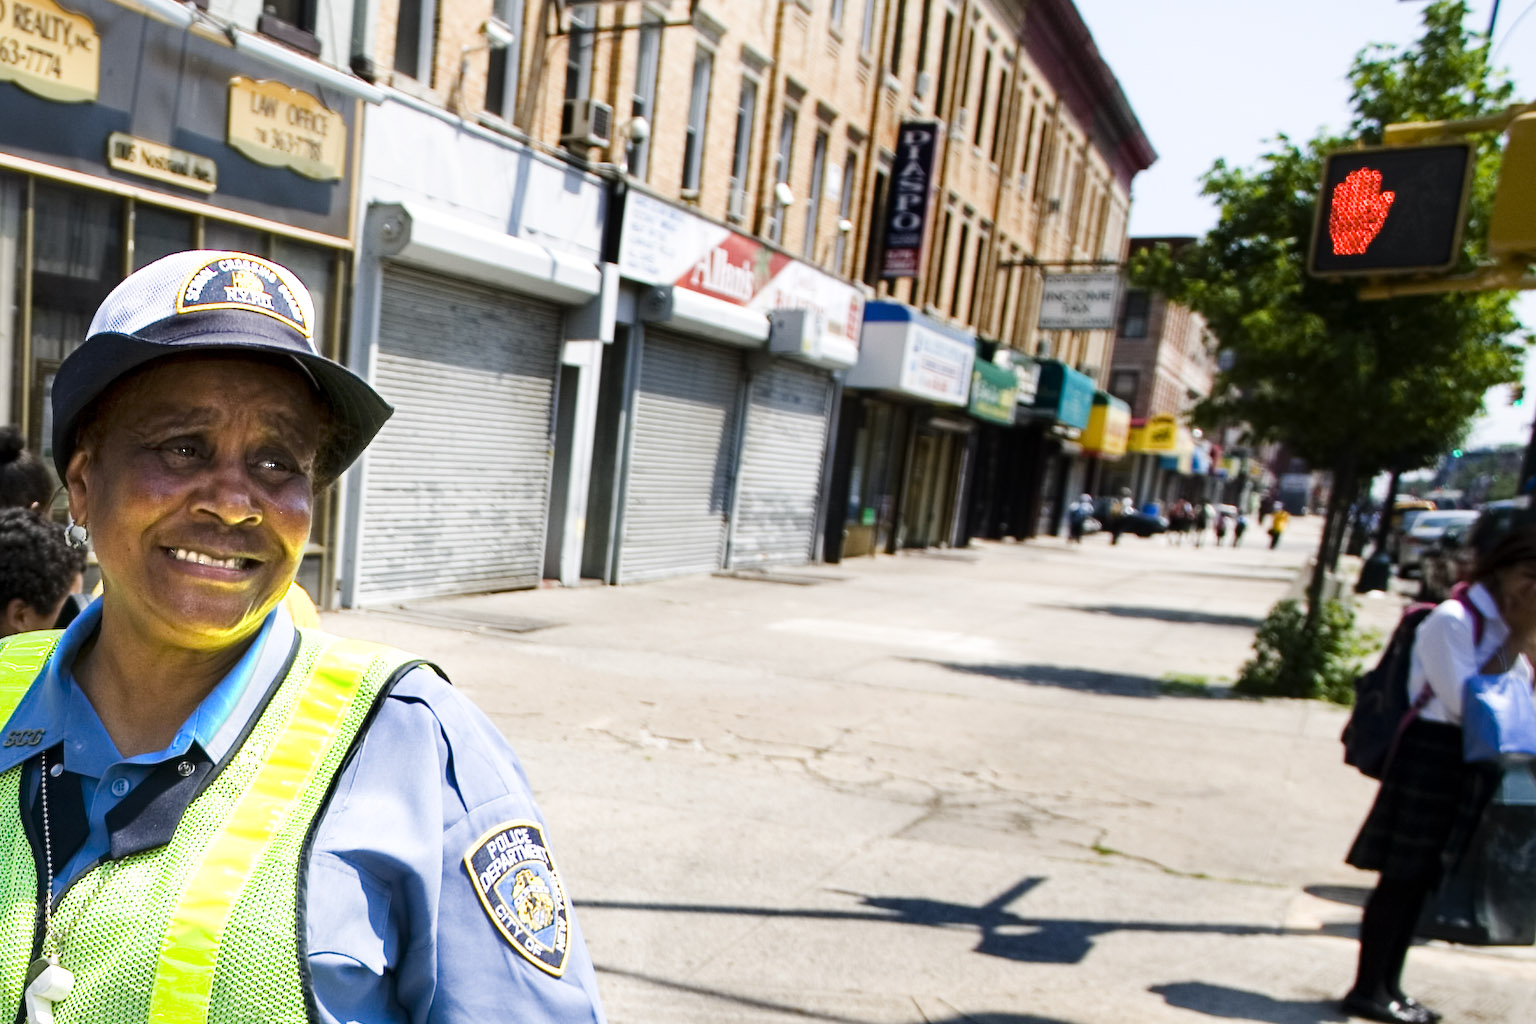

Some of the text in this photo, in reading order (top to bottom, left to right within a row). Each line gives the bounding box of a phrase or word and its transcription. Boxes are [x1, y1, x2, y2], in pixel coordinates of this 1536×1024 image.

[479, 843, 549, 894] DEPARTMENT
[486, 828, 532, 860] POLICE
[495, 904, 525, 937] CITY
[524, 938, 543, 957] OF
